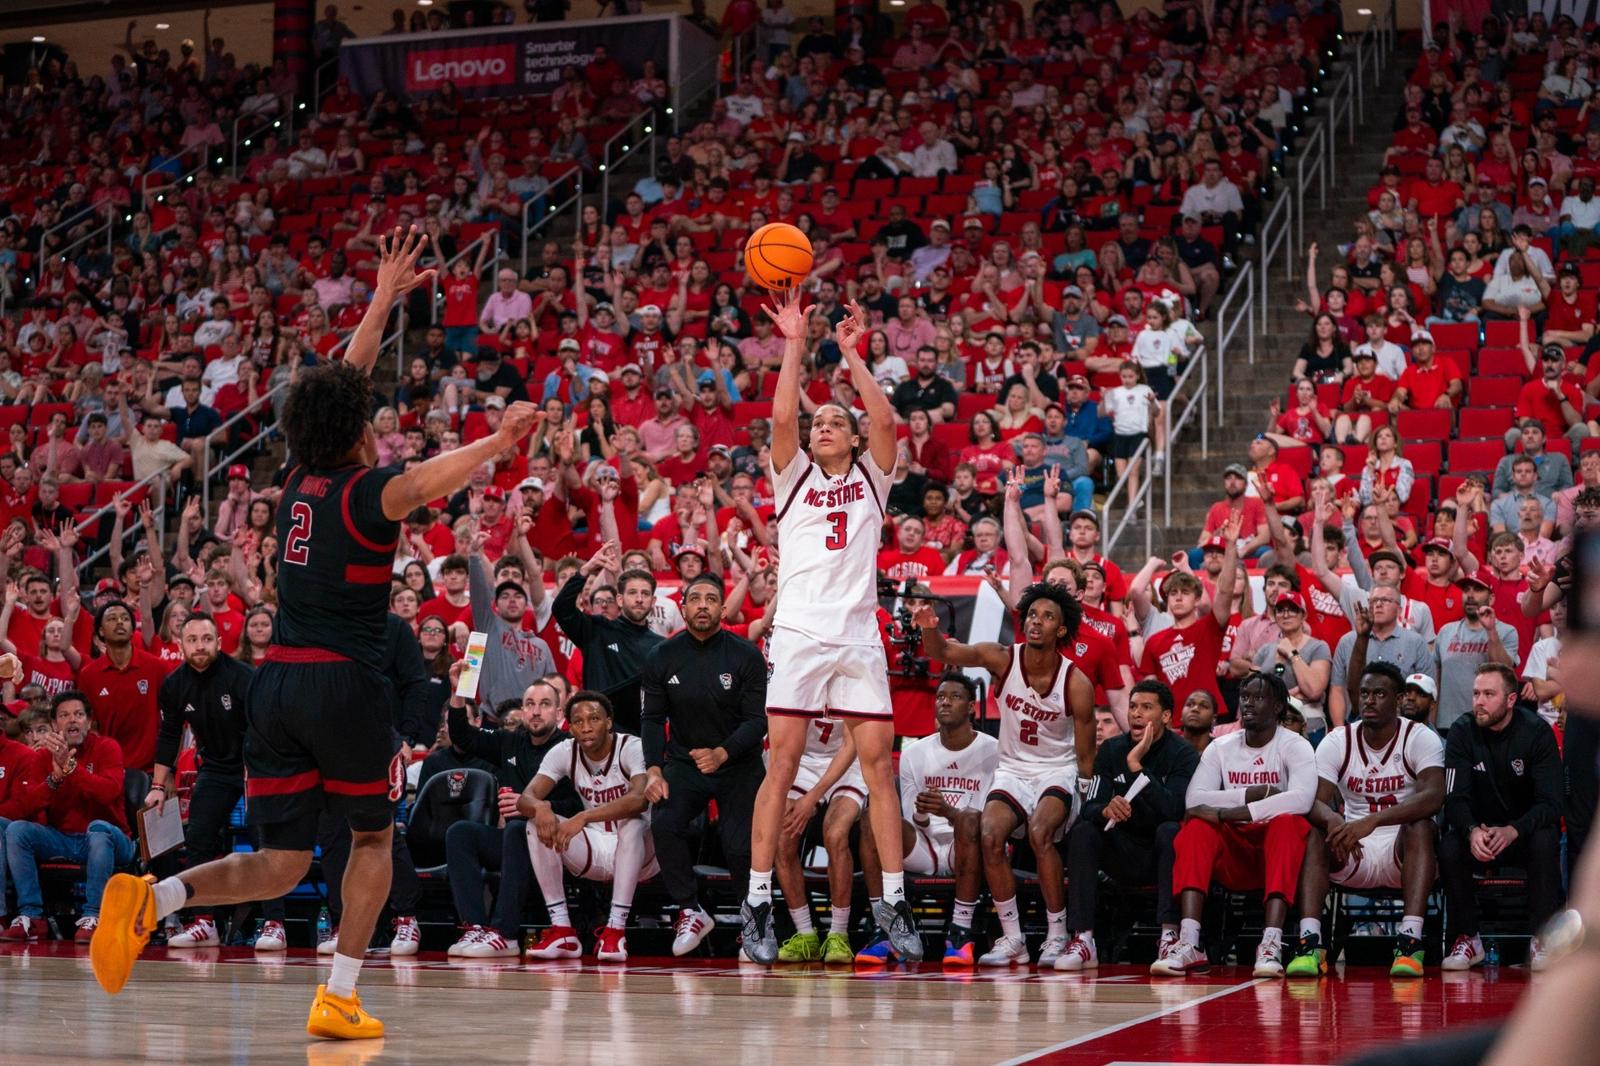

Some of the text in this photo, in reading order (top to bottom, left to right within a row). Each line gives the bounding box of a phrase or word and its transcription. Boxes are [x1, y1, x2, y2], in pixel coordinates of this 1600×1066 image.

[526, 40, 577, 55] Smarter
[415, 57, 506, 82] Lenovo
[525, 53, 596, 68] technology
[525, 68, 560, 83] for all
[803, 481, 865, 508] NC STATE
[284, 501, 312, 566] 2
[825, 510, 848, 551] 3
[1005, 693, 1061, 722] NC STATE
[814, 720, 834, 745] 7
[1020, 720, 1039, 746] 2
[594, 783, 627, 803] STATE
[924, 776, 981, 791] WOLFPACK
[1347, 775, 1405, 793] NC STATE
